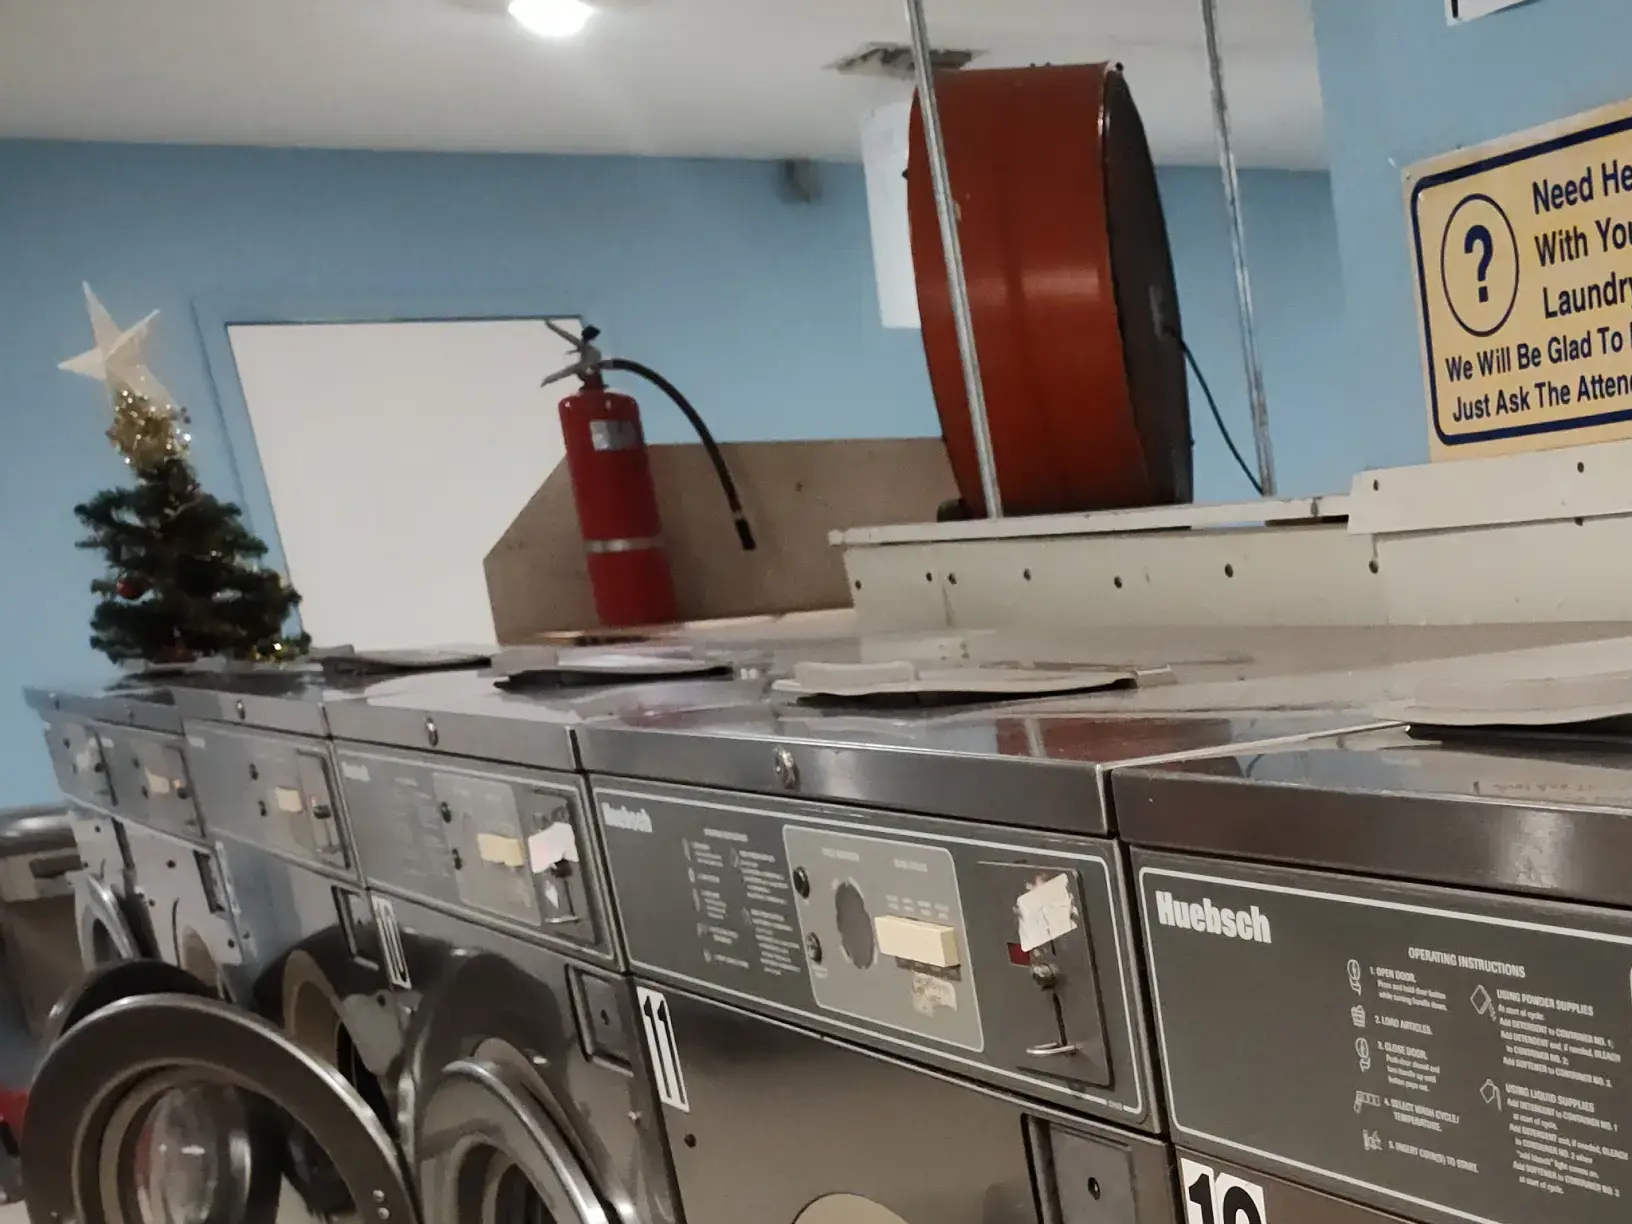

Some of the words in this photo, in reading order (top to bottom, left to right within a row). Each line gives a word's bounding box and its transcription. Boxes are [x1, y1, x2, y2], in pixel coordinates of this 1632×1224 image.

[1532, 167, 1593, 214] Need
[1534, 226, 1588, 266] With
[1445, 356, 1473, 382] We
[1477, 345, 1511, 376] Will
[1517, 342, 1541, 369] Be
[1547, 331, 1592, 364] Glad
[1597, 325, 1623, 355] To
[1452, 397, 1491, 422] Just
[1495, 385, 1531, 415] Ask
[1534, 380, 1571, 408] The
[1155, 890, 1272, 944] Huebsch
[1408, 947, 1457, 966] OPERATING
[1458, 955, 1526, 979] INSTRUCTIONS
[643, 995, 687, 1105] 11
